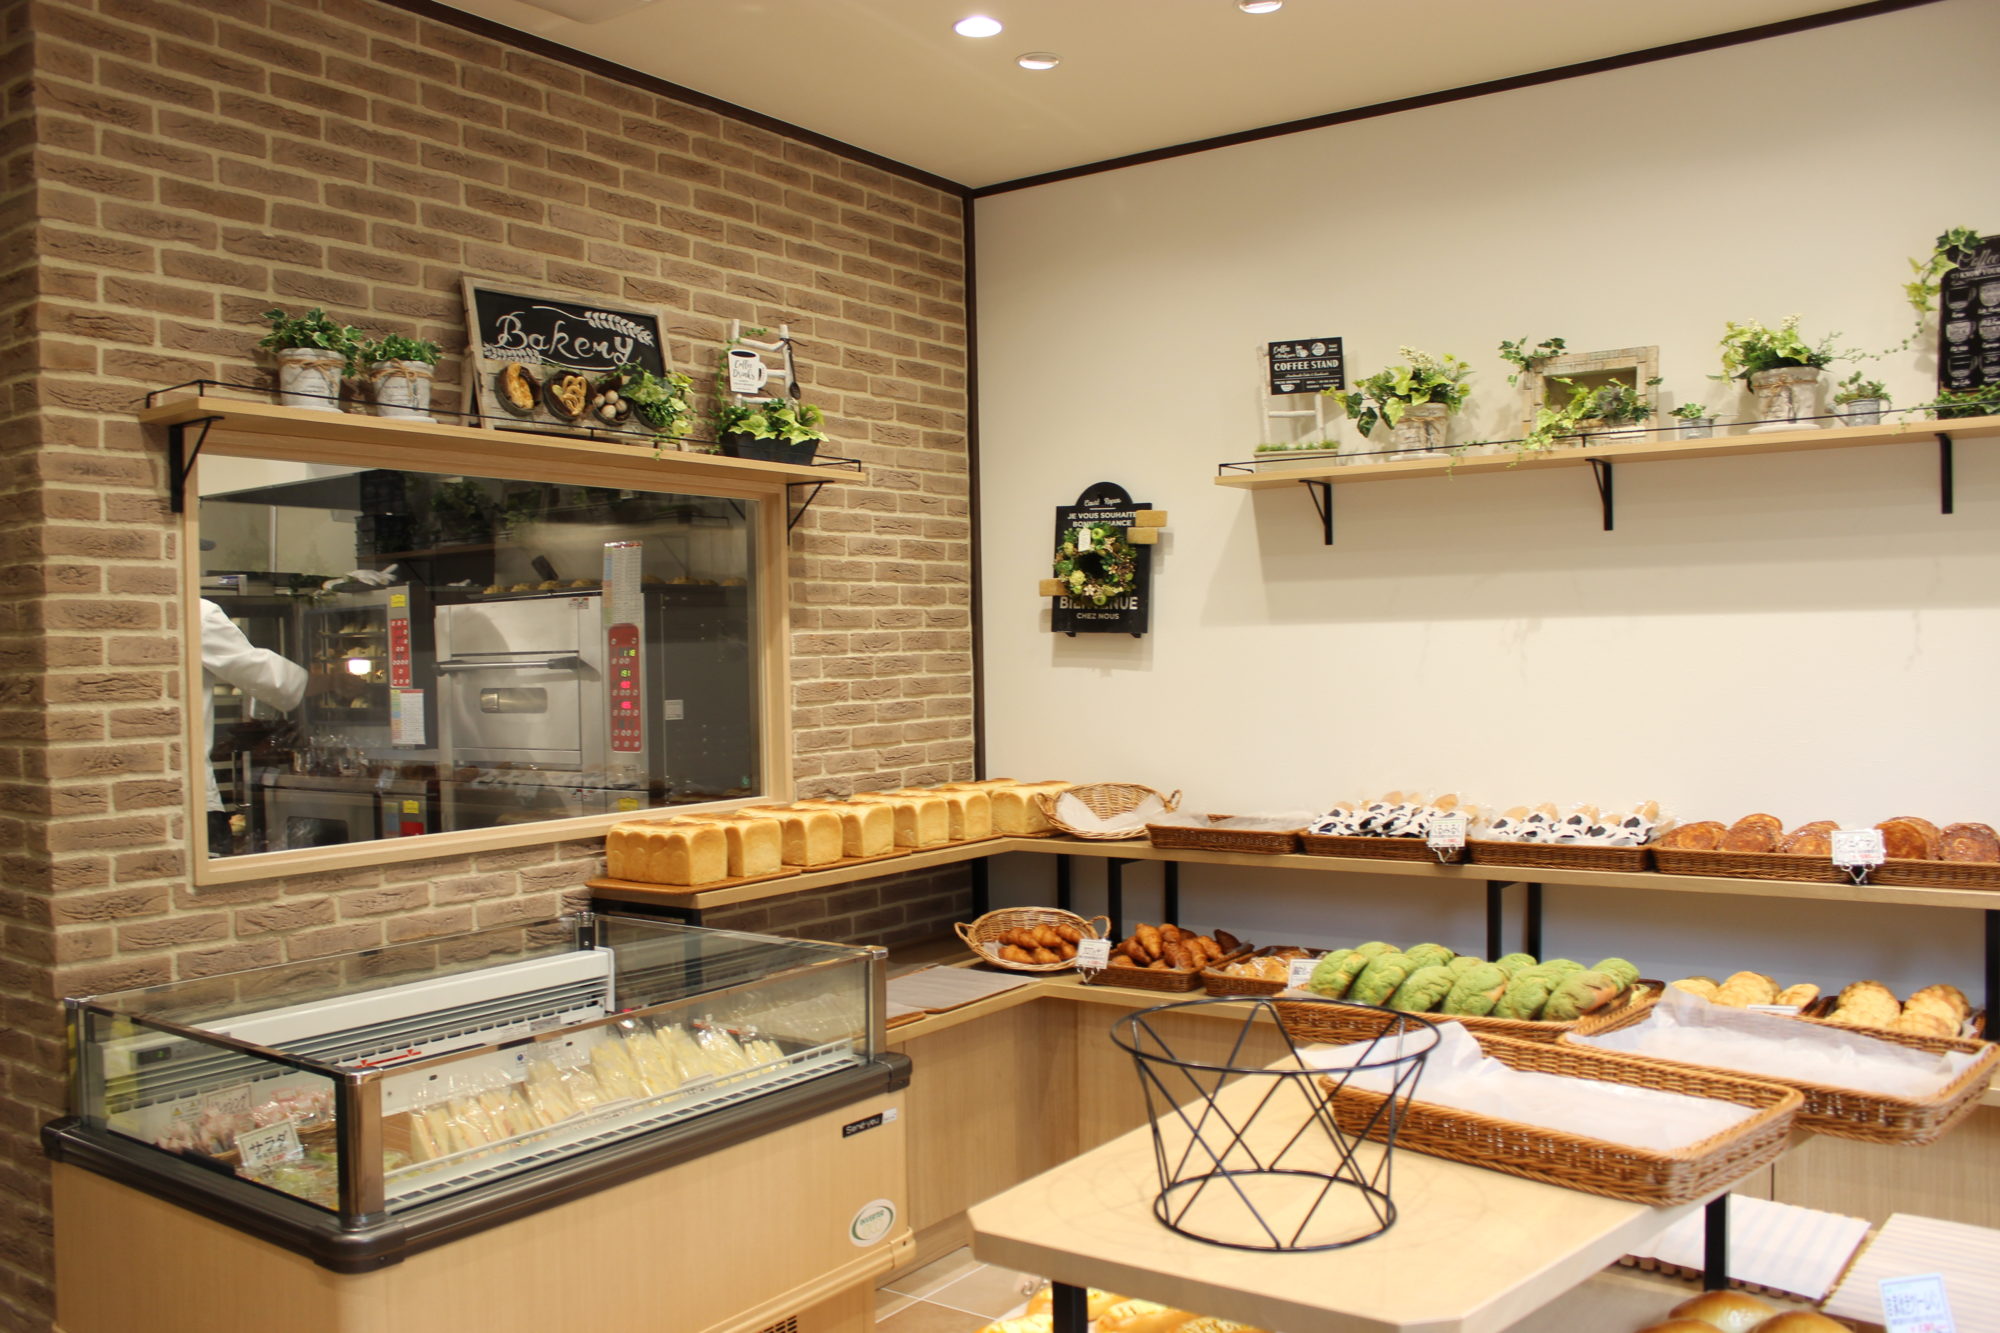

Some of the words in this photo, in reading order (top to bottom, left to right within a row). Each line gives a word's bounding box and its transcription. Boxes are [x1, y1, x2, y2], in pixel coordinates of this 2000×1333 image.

[495, 312, 635, 365] Bakery
[1274, 361, 1310, 371] COFFEE
[1311, 359, 1339, 369] STAND
[1098, 612, 1120, 620] NOUS
